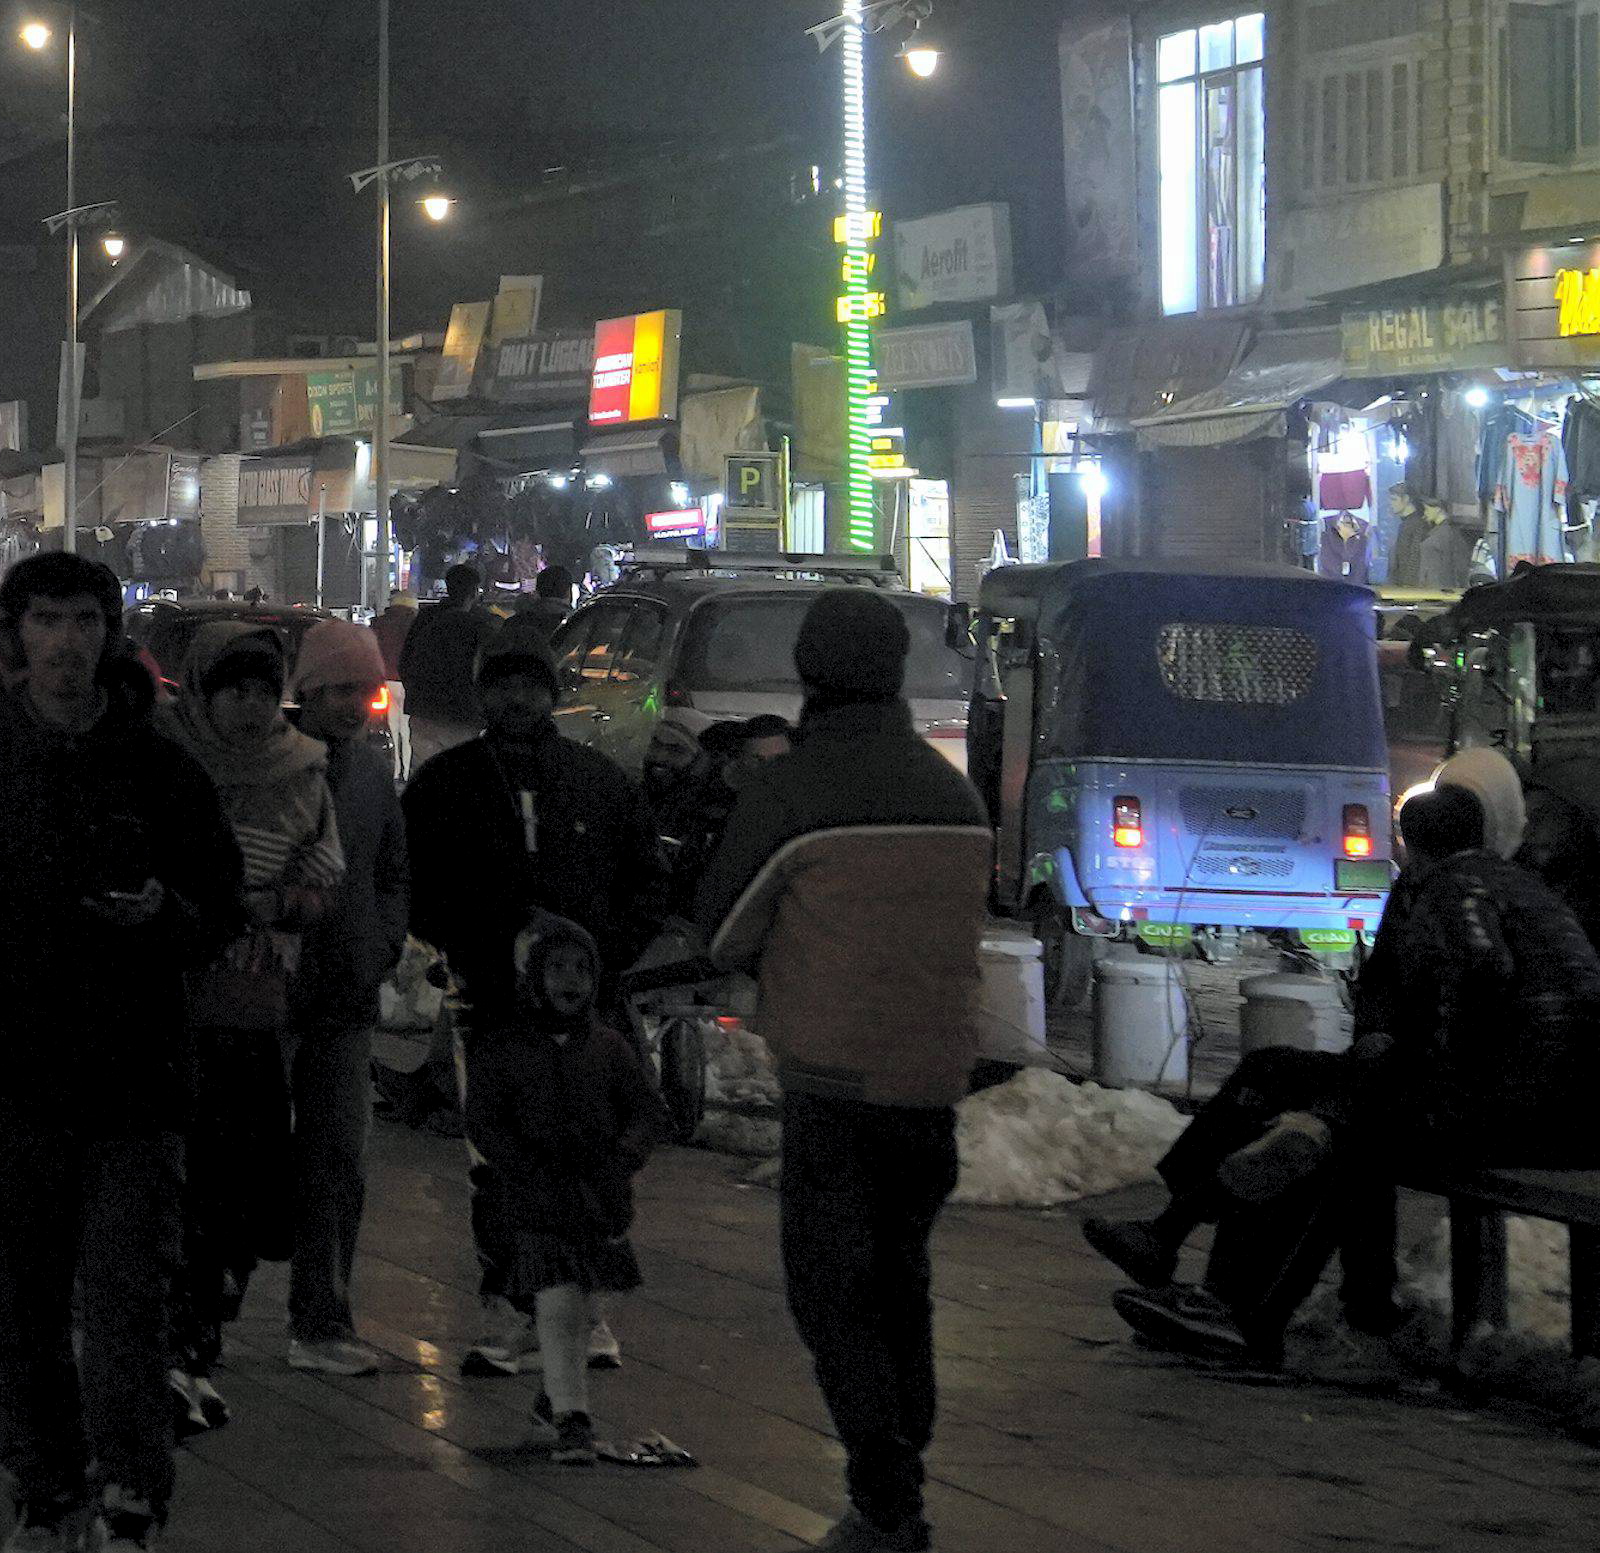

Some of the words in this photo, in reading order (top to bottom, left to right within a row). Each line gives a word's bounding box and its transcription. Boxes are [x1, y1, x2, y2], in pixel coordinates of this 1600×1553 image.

[1369, 306, 1434, 352] REGAL
[497, 343, 537, 377] BHAT
[740, 466, 761, 494] P
